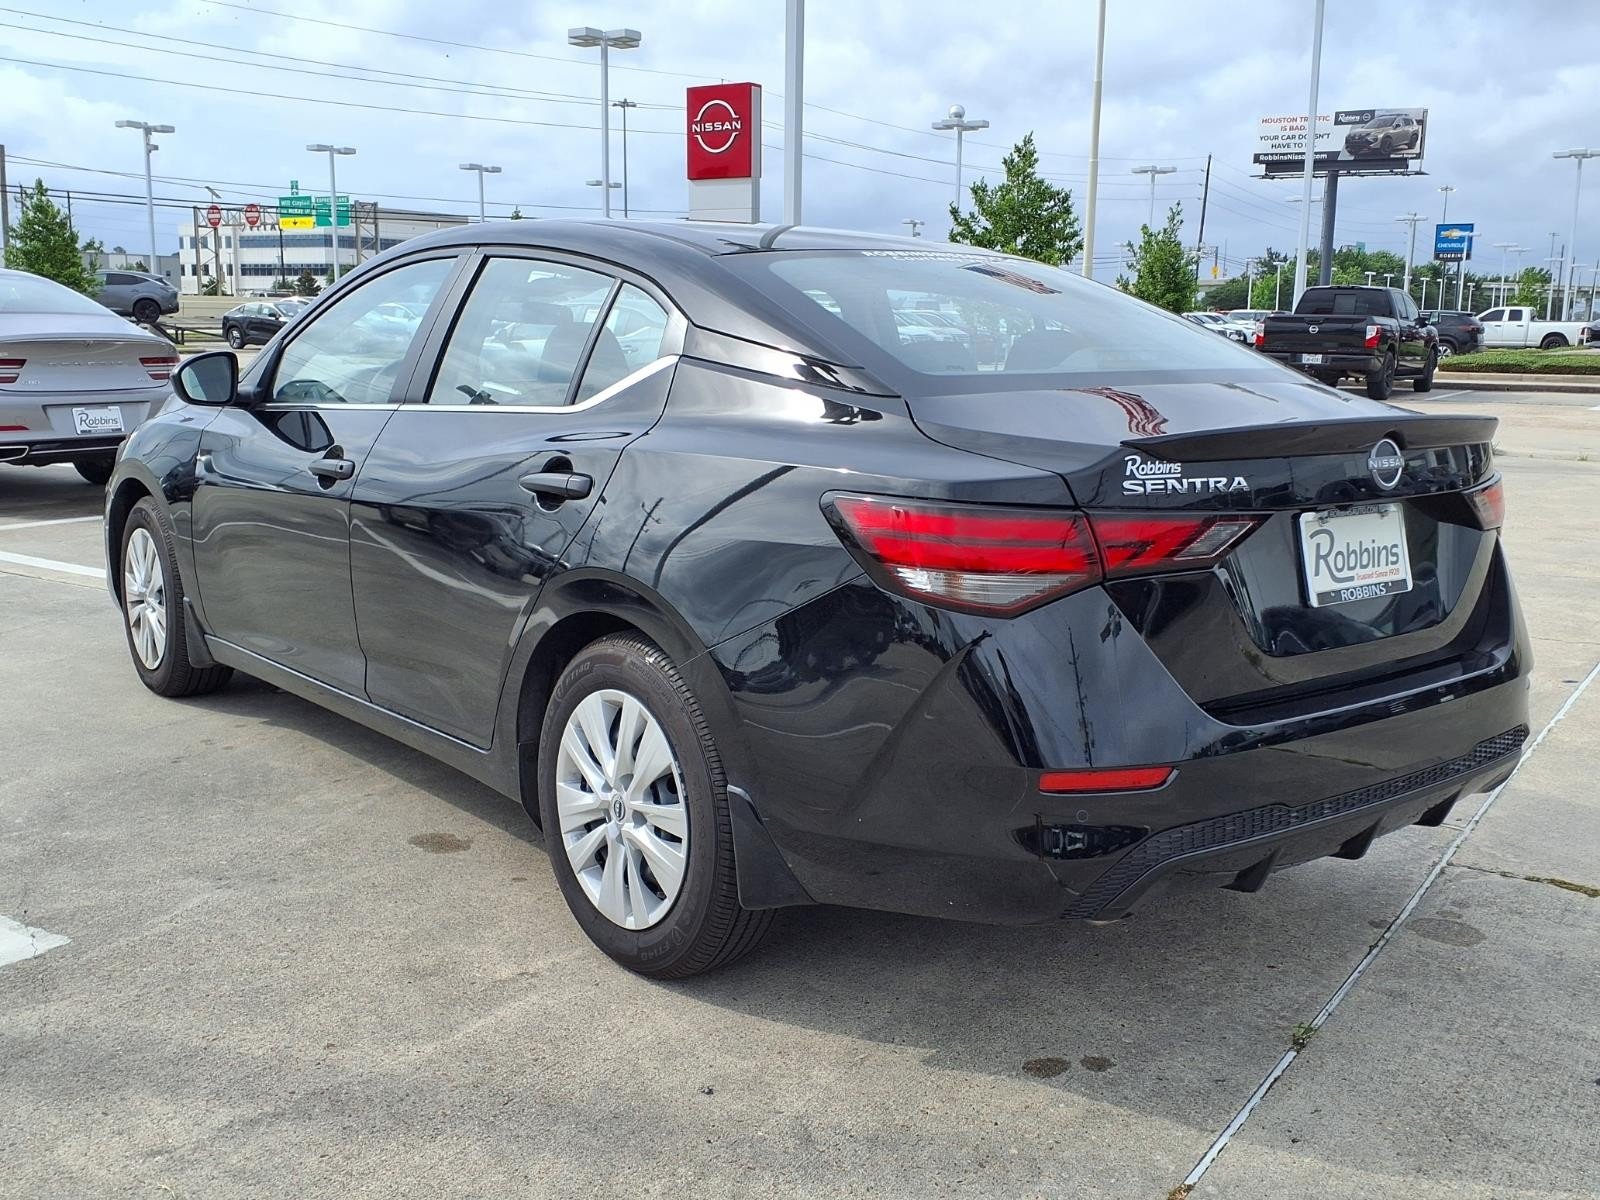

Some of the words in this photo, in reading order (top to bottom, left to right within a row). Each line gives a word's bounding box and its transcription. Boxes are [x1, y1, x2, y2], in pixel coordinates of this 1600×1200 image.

[692, 120, 741, 132] NISSAN
[1261, 116, 1298, 124] HOUSTON
[1300, 115, 1330, 123] TRFIC
[1298, 132, 1331, 140] DOSN'T
[78, 412, 119, 428] Robbins
[1124, 454, 1182, 479] Robbins
[1369, 457, 1404, 470] NISSAN
[1122, 476, 1250, 496] SENTRA
[1309, 528, 1400, 584] Robbins
[1341, 583, 1387, 601] ROBBINS
